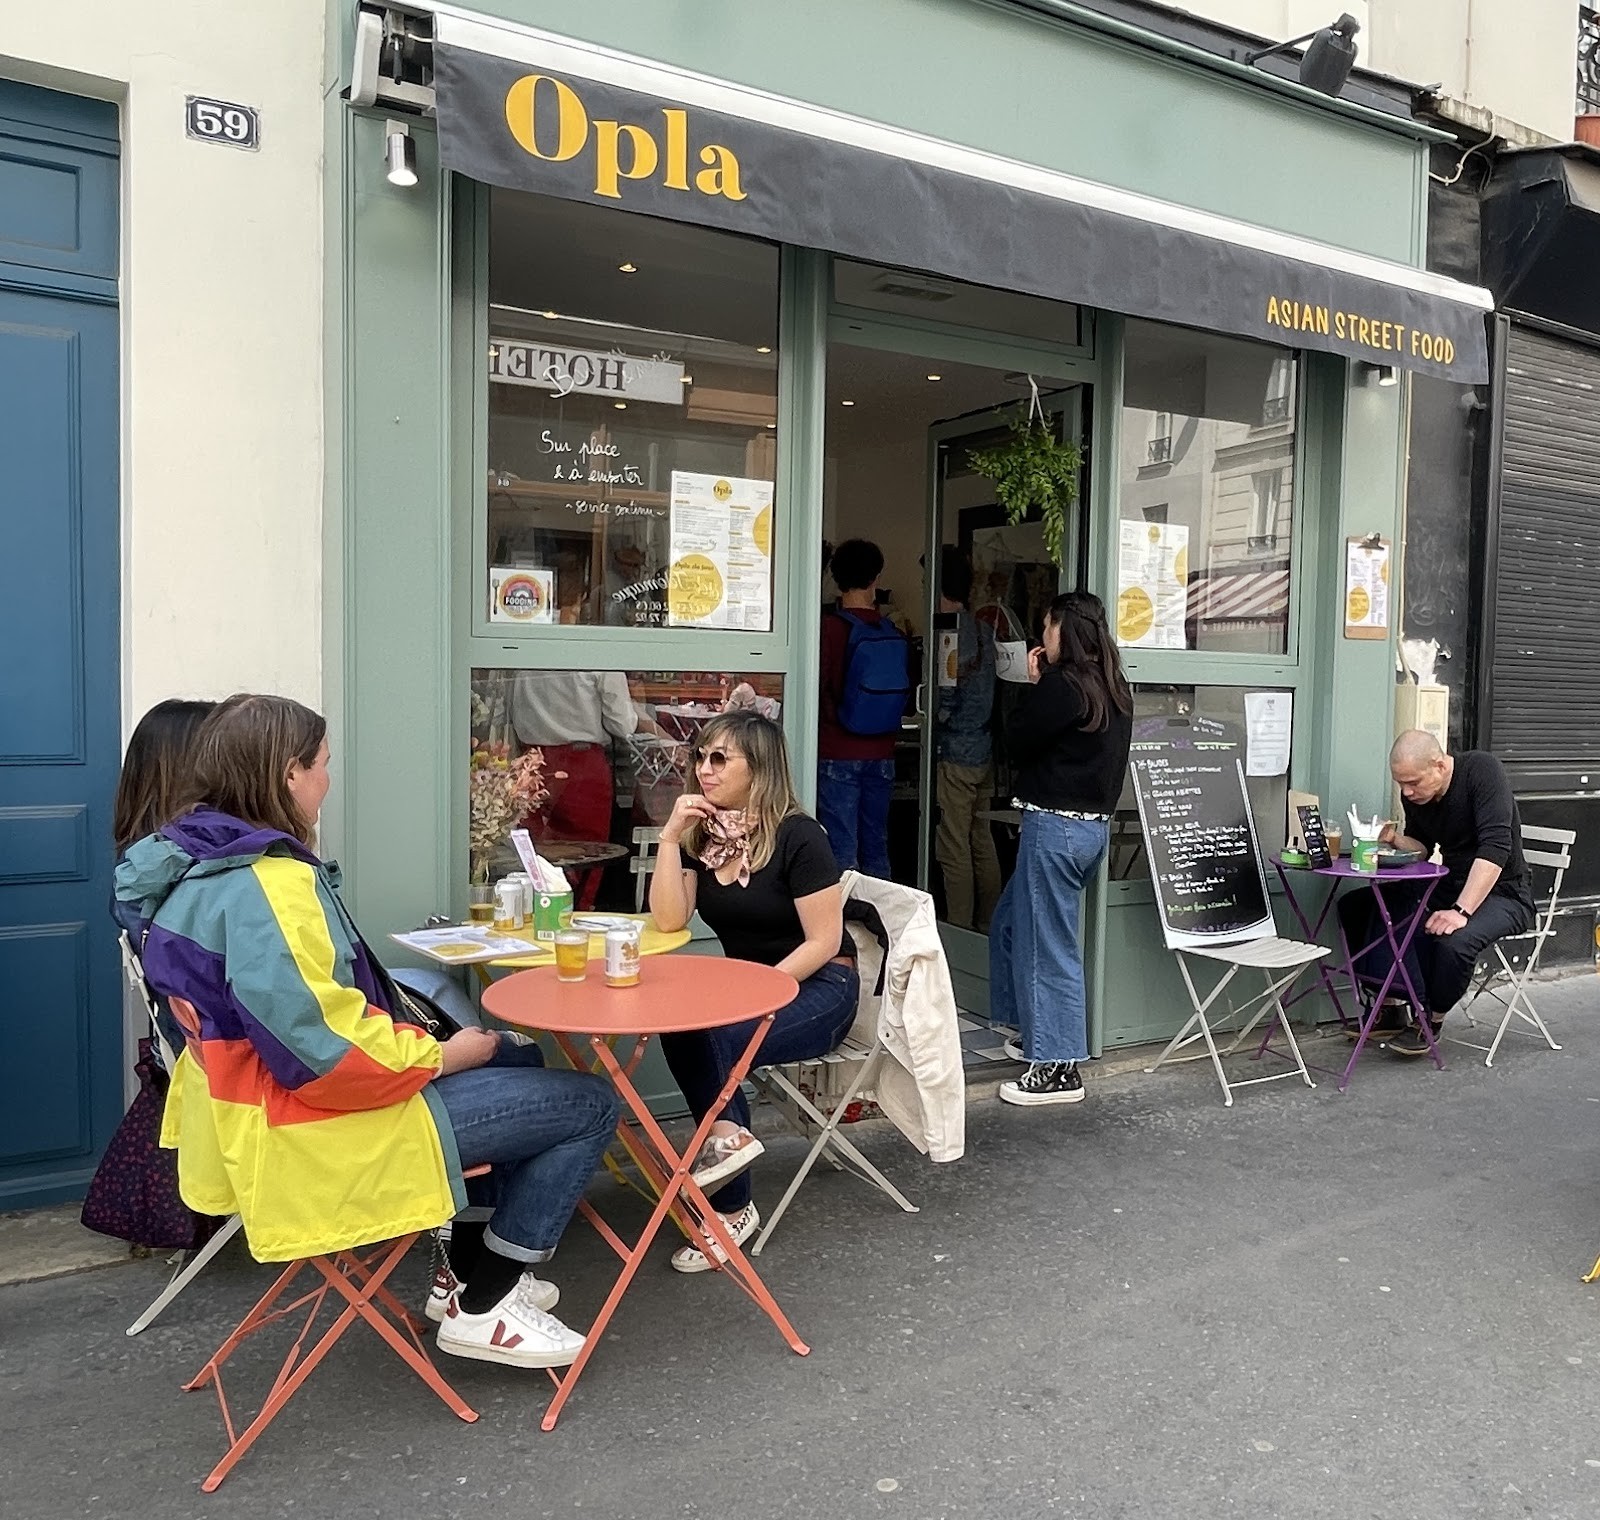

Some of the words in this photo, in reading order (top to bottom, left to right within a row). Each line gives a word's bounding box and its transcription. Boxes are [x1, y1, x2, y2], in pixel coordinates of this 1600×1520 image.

[196, 103, 248, 140] 59
[505, 74, 747, 201] Opla
[1267, 296, 1329, 336] ASIAN
[1335, 311, 1405, 352] STREET
[1411, 330, 1455, 365] FOOD
[537, 430, 572, 454] Sur
[578, 436, 620, 464] place
[567, 459, 583, 481] à
